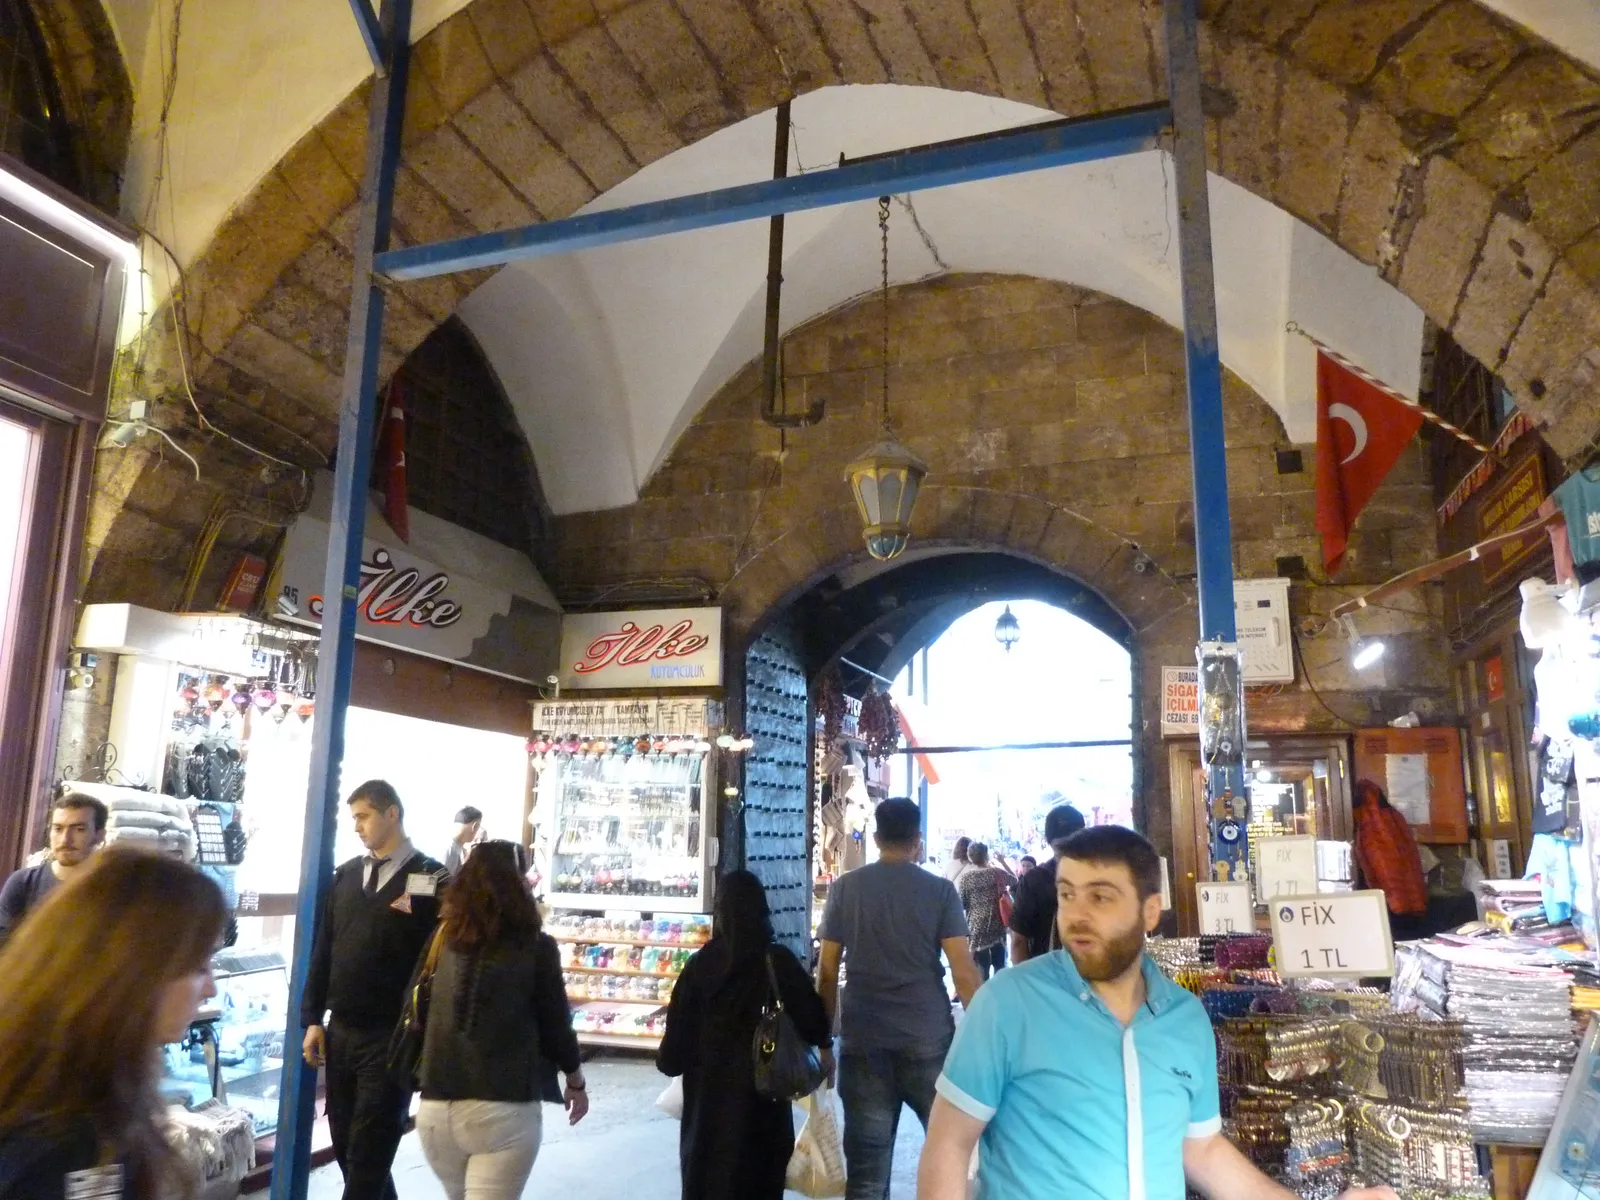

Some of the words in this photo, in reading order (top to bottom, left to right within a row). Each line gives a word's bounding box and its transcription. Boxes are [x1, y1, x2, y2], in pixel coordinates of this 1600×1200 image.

[573, 619, 709, 673] İlke
[1167, 698, 1198, 712] İÇİLM
[1301, 902, 1335, 926] FİX
[1301, 949, 1314, 968] 1
[1319, 948, 1348, 968] TL
